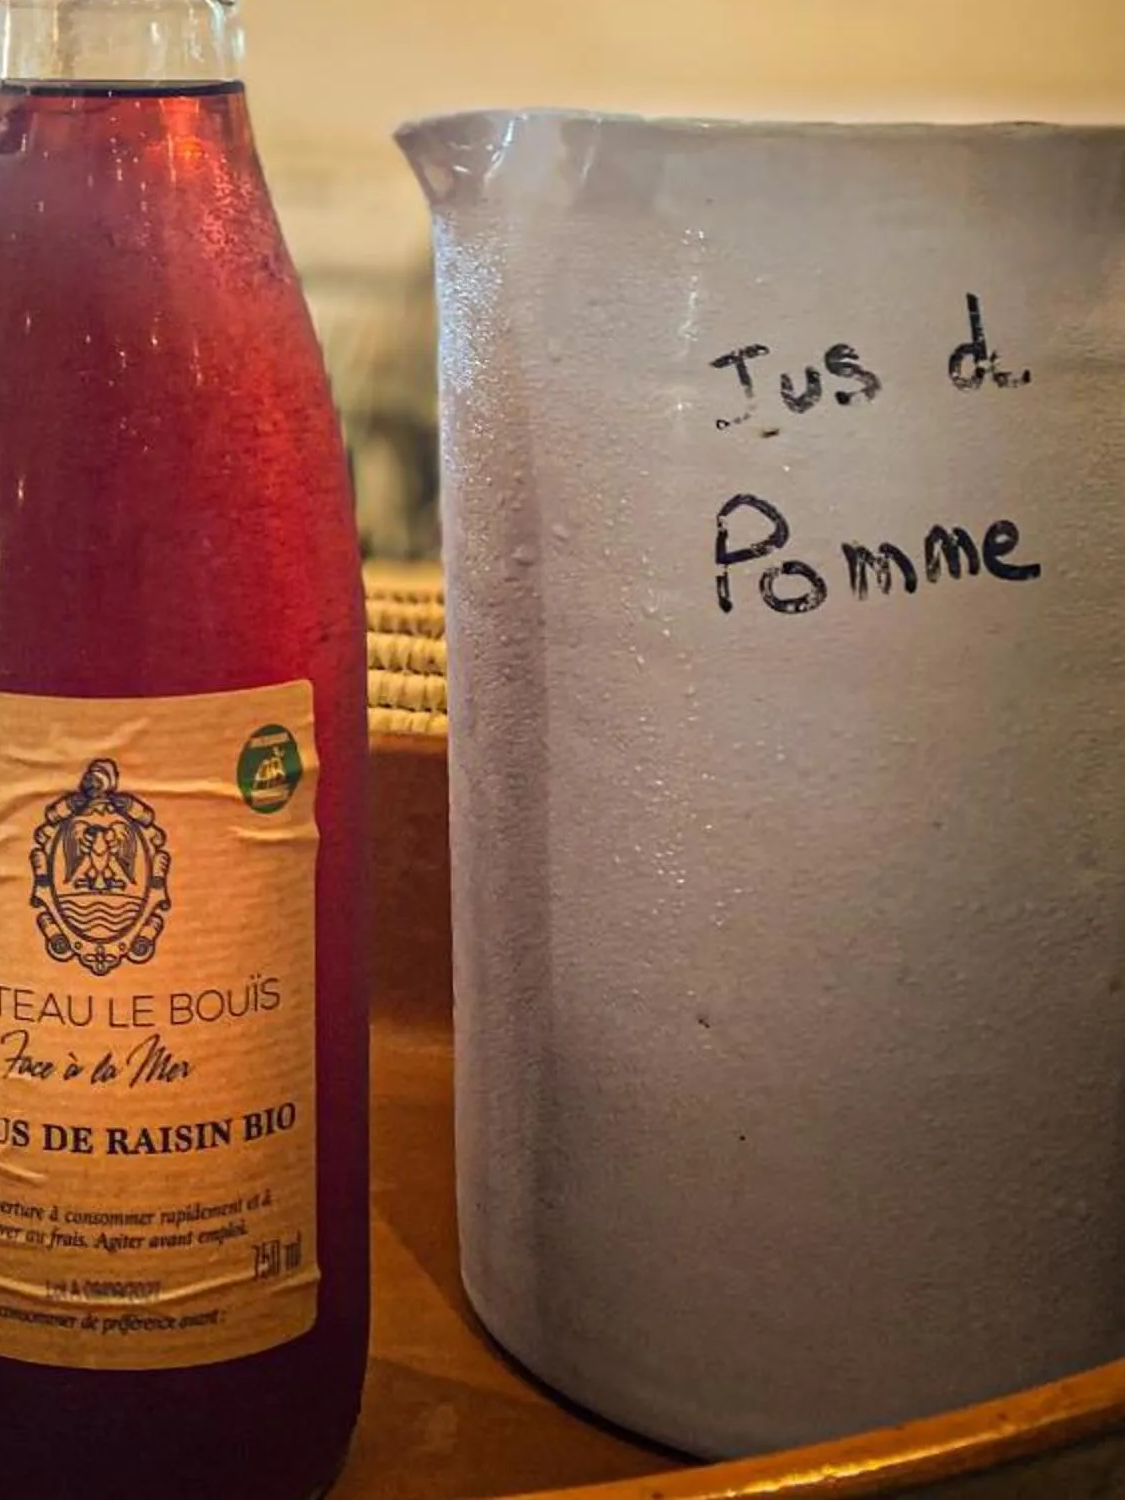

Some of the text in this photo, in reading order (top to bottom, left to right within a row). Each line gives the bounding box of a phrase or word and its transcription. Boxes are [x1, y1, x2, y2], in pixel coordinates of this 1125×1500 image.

[710, 343, 882, 430] Jus
[715, 493, 1042, 614] Pomme
[107, 993, 156, 1028] LE
[169, 973, 281, 1026] BOUÏS
[0, 1029, 194, 1088] Face à la Mer
[42, 1123, 94, 1155] DE
[106, 1118, 234, 1156] RAISIN
[242, 1102, 297, 1142] BIO
[25, 1229, 46, 1245] au
[45, 1227, 89, 1250] frais.
[94, 1232, 144, 1253] Agiter
[148, 1231, 194, 1249] avant
[49, 1204, 60, 1223] à
[65, 1209, 155, 1226] consommer
[160, 1196, 243, 1230] rapidement
[81, 1313, 101, 1331] de
